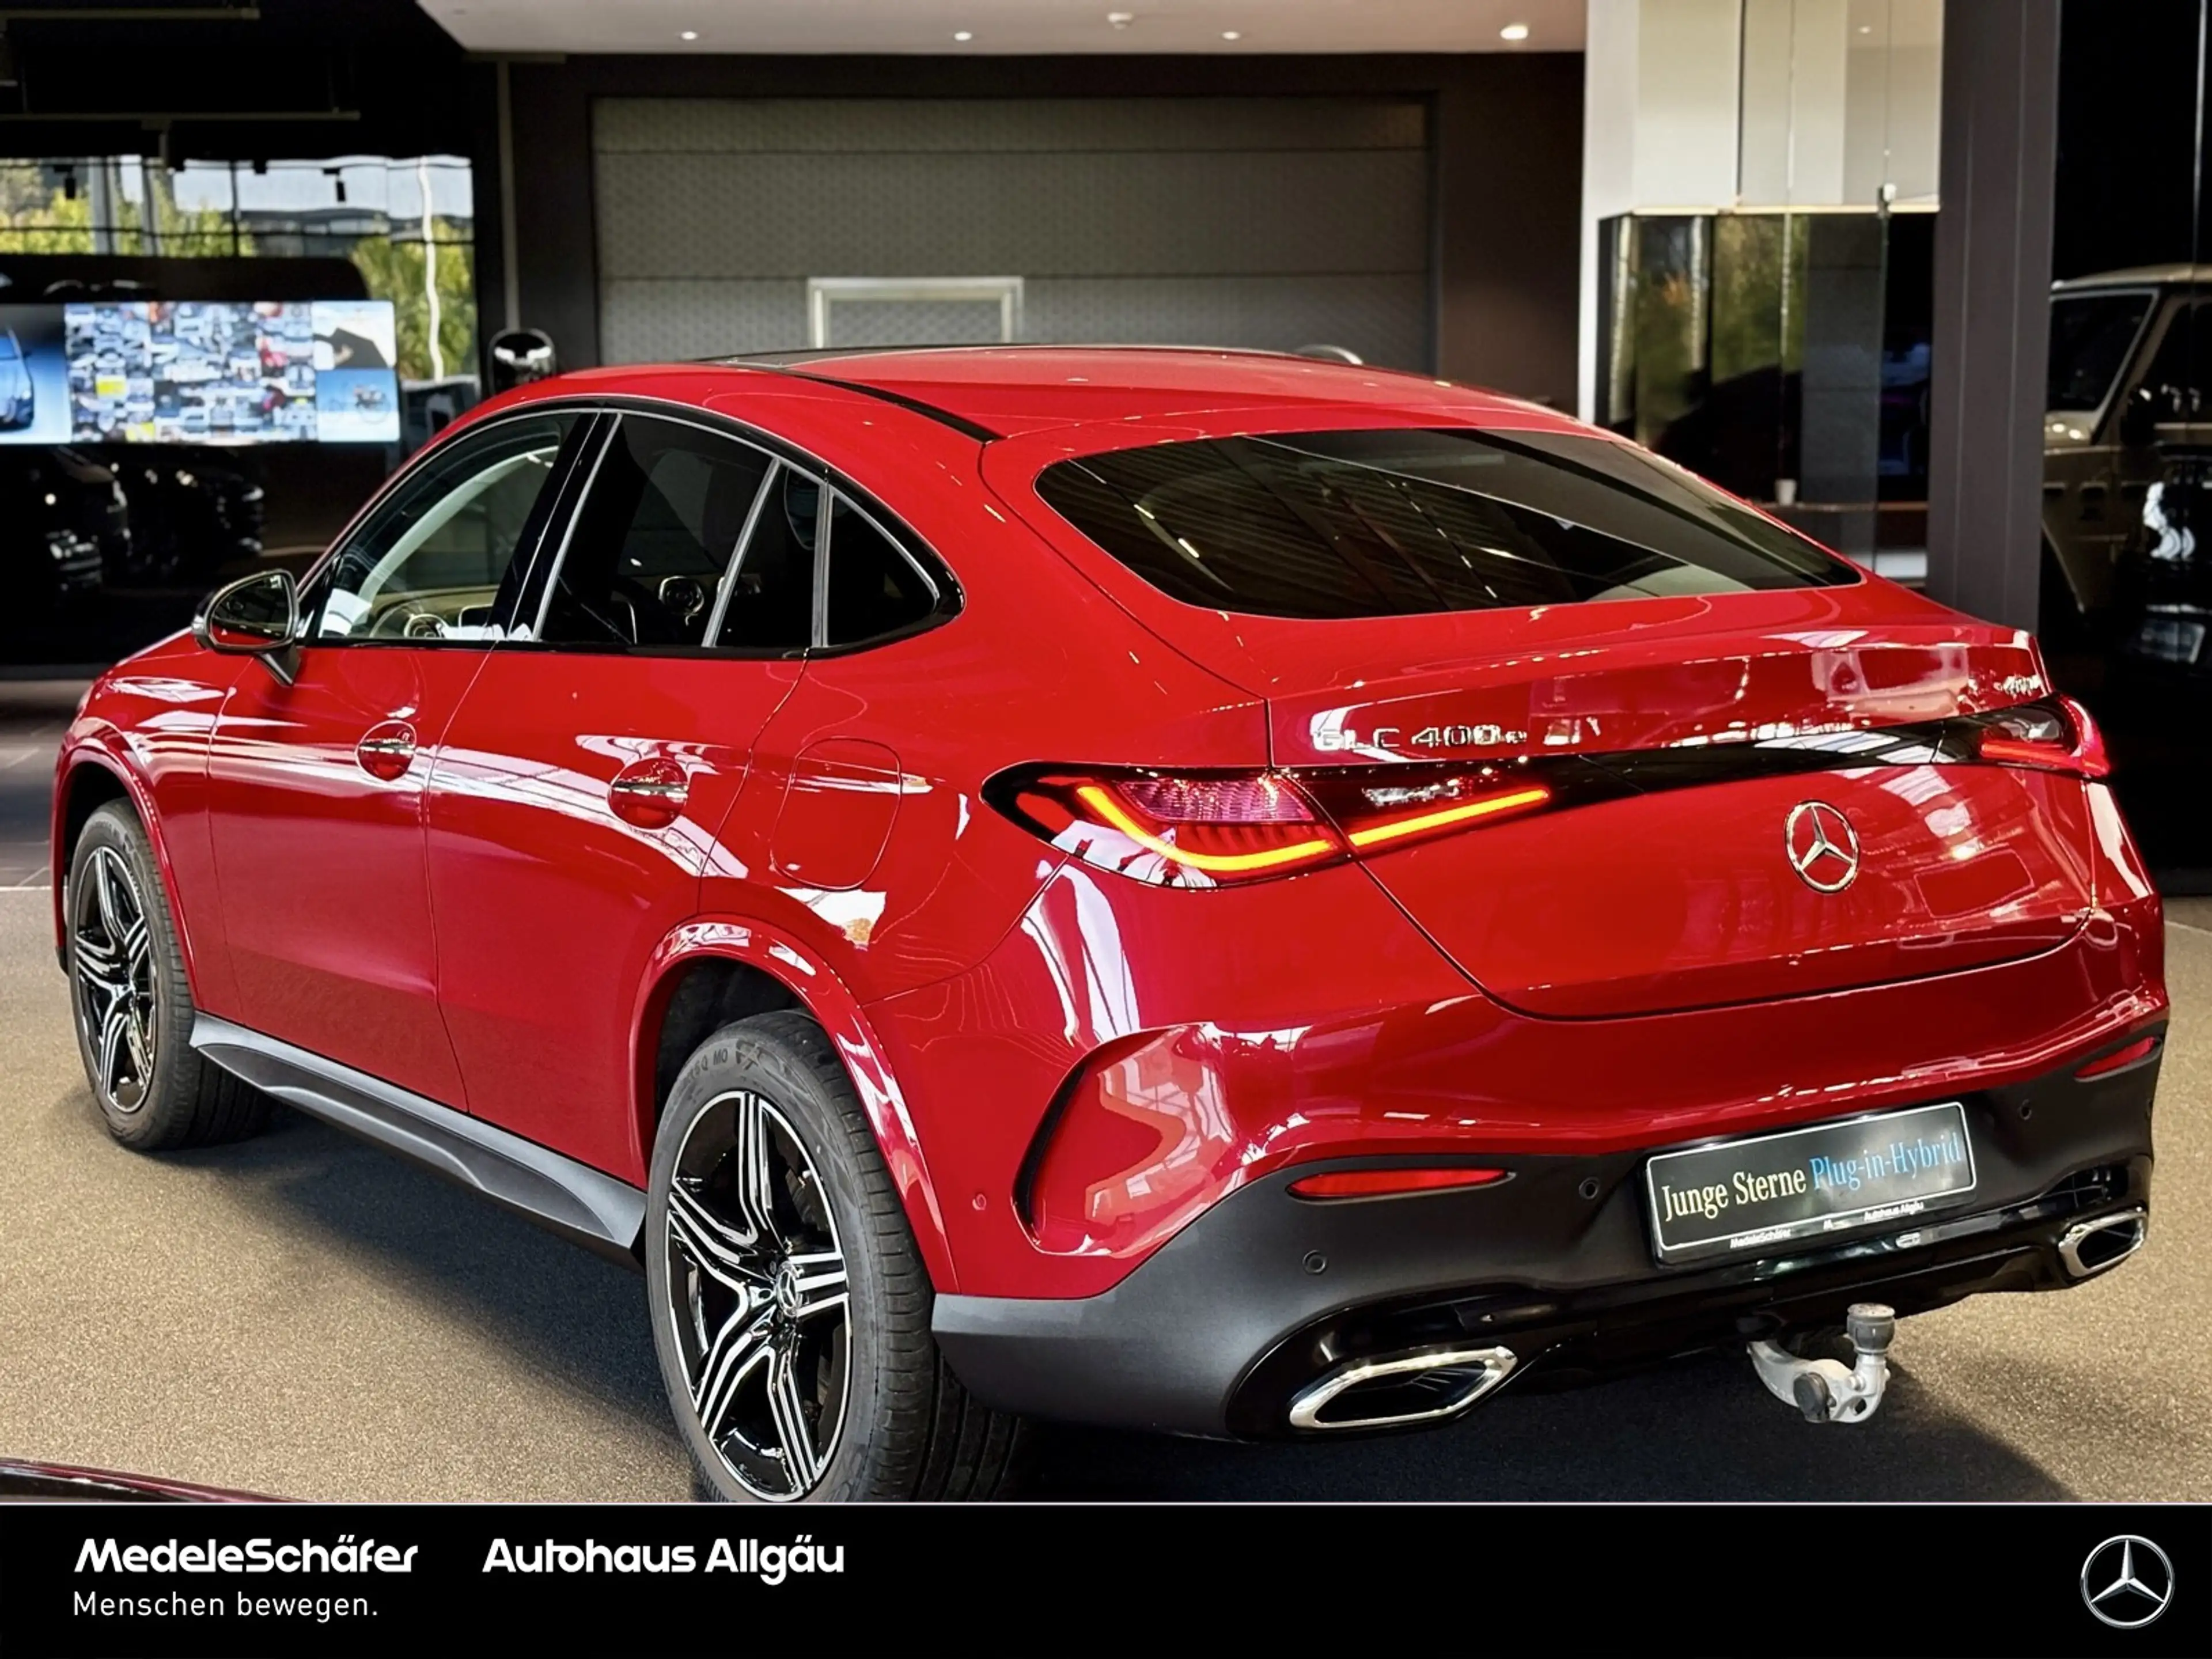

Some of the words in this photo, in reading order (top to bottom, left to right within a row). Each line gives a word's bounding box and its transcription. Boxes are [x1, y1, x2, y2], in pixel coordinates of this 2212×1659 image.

[1313, 727, 1401, 751] GLC
[1661, 1181, 1728, 1222] Junge
[1732, 1168, 1807, 1205] Sterne
[1809, 1132, 1962, 1192] Plug-in-Hybrid
